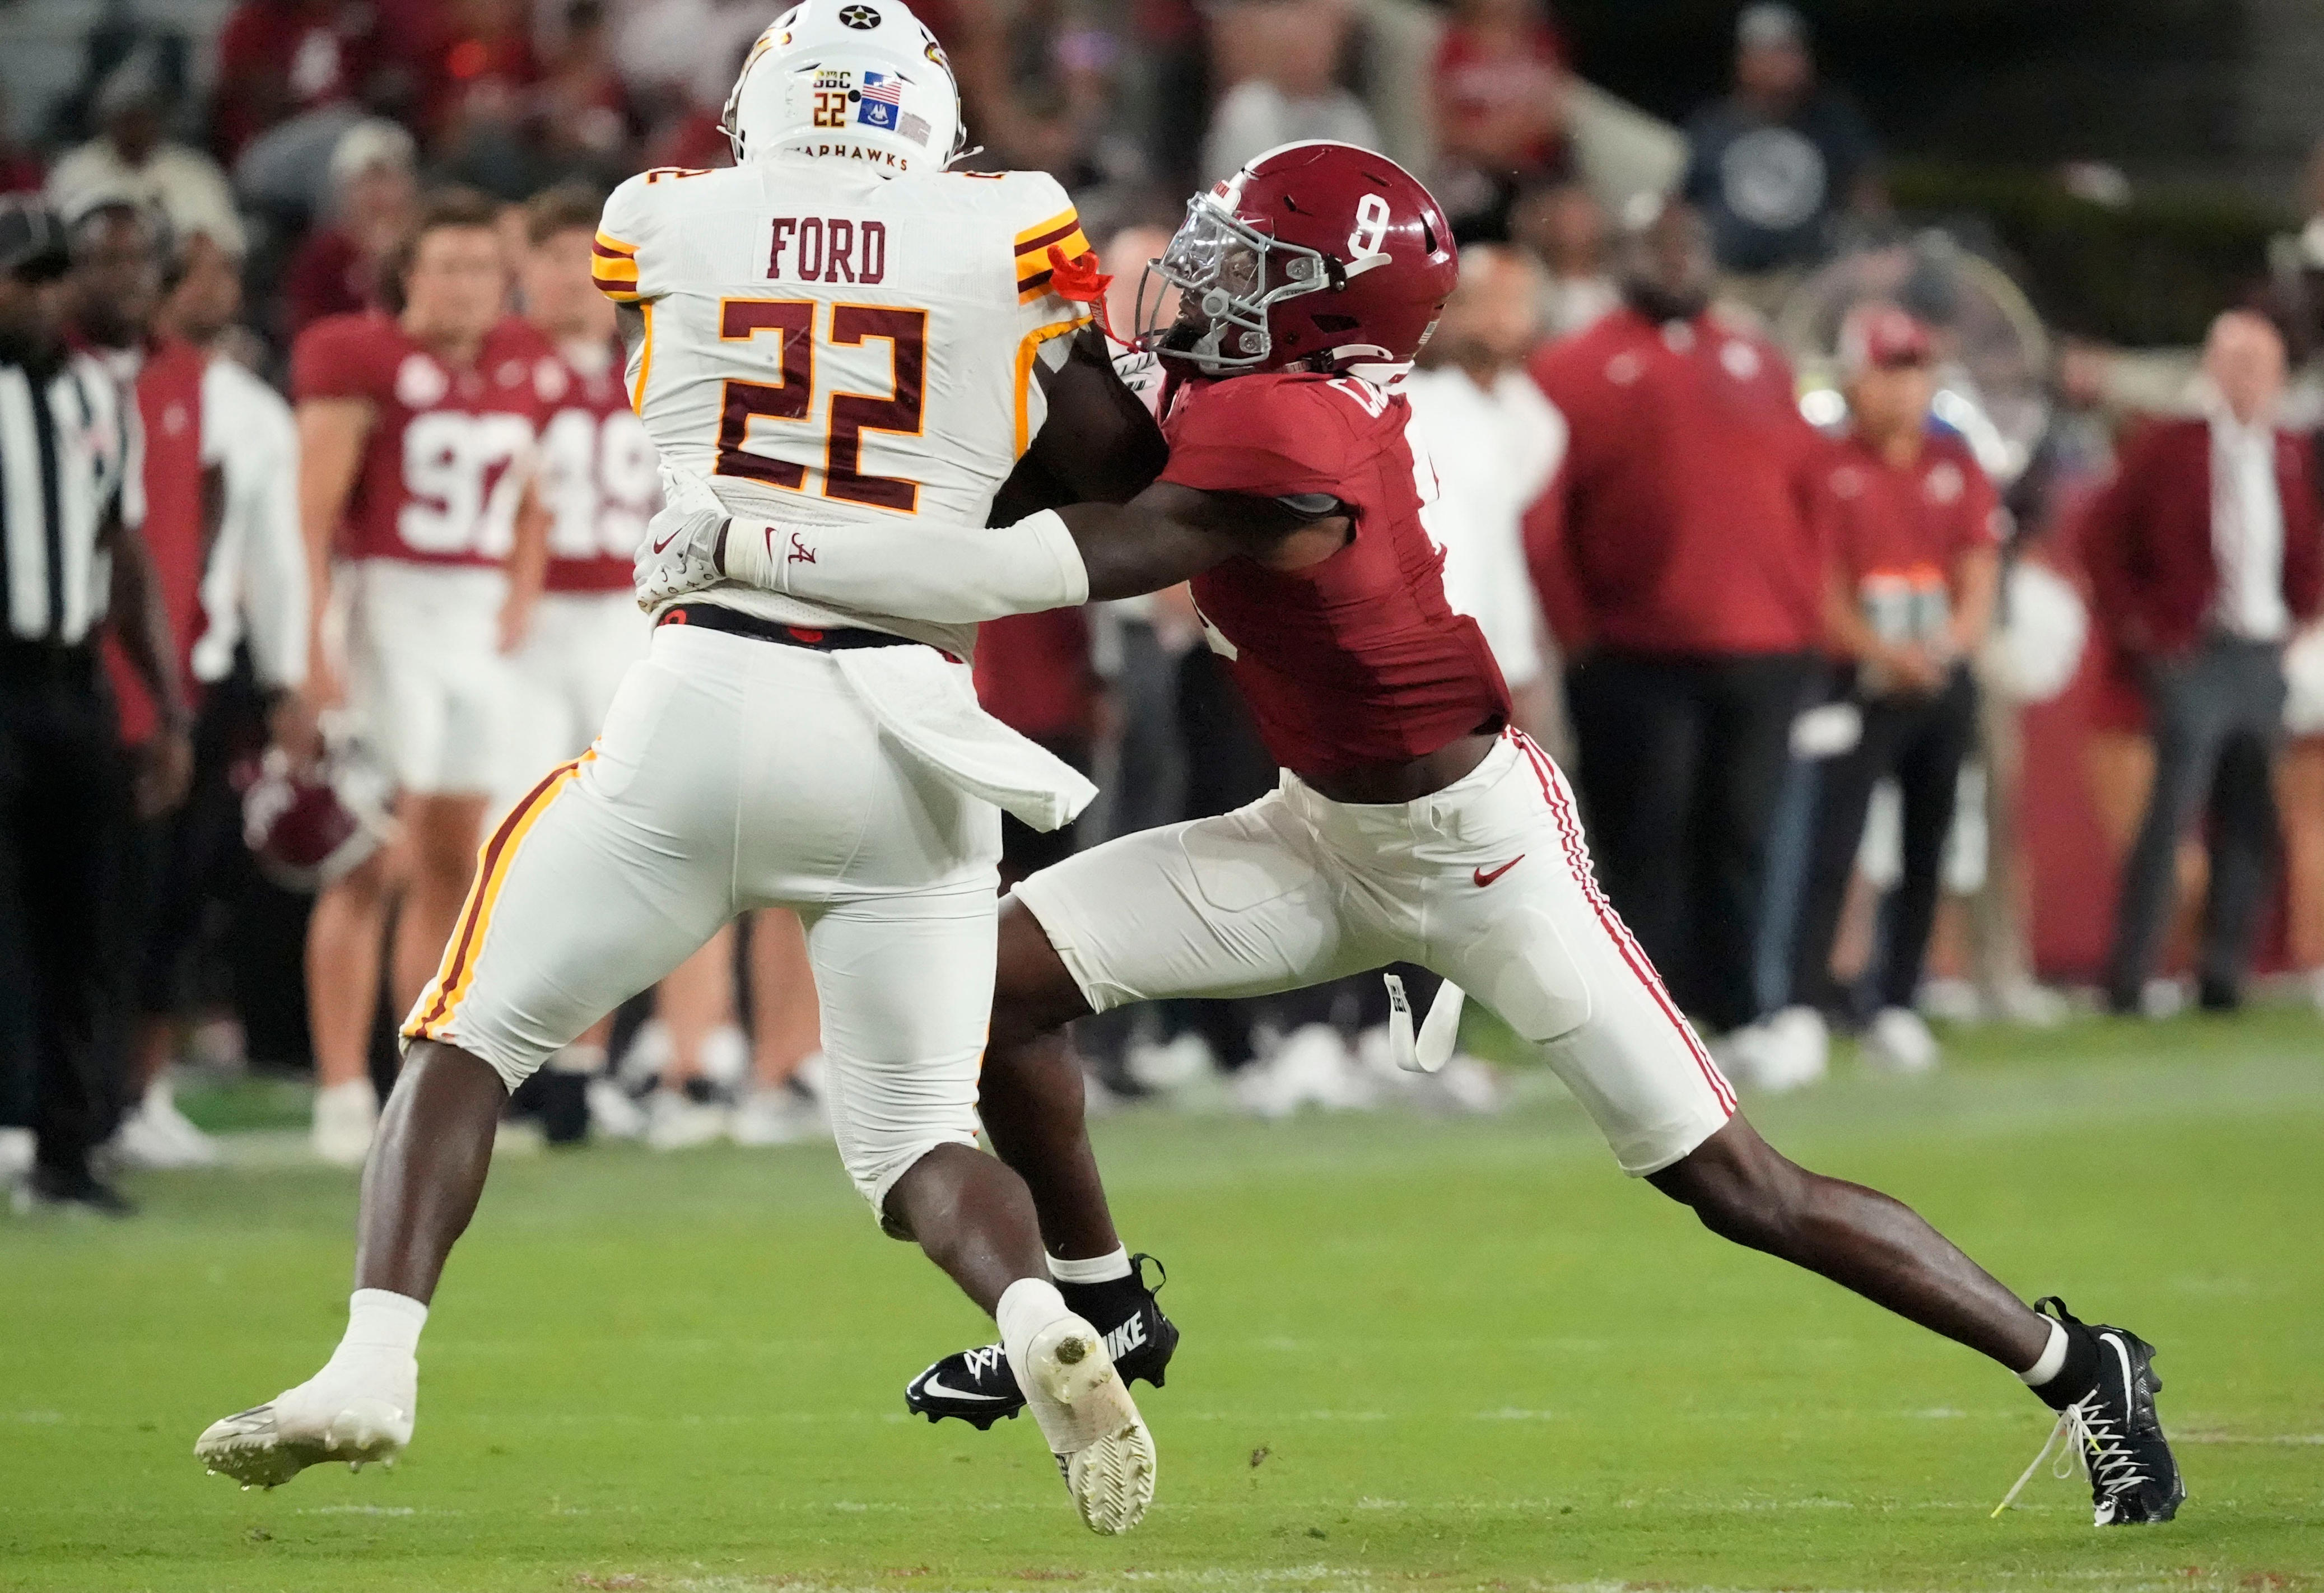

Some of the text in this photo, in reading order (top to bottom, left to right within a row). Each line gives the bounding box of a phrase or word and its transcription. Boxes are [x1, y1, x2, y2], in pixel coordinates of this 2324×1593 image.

[813, 92, 846, 128] 22
[785, 144, 907, 171] ARHAWKS
[766, 217, 886, 285] FORD
[1347, 193, 1391, 260] 9
[713, 297, 929, 515] 22
[396, 409, 537, 558] 97
